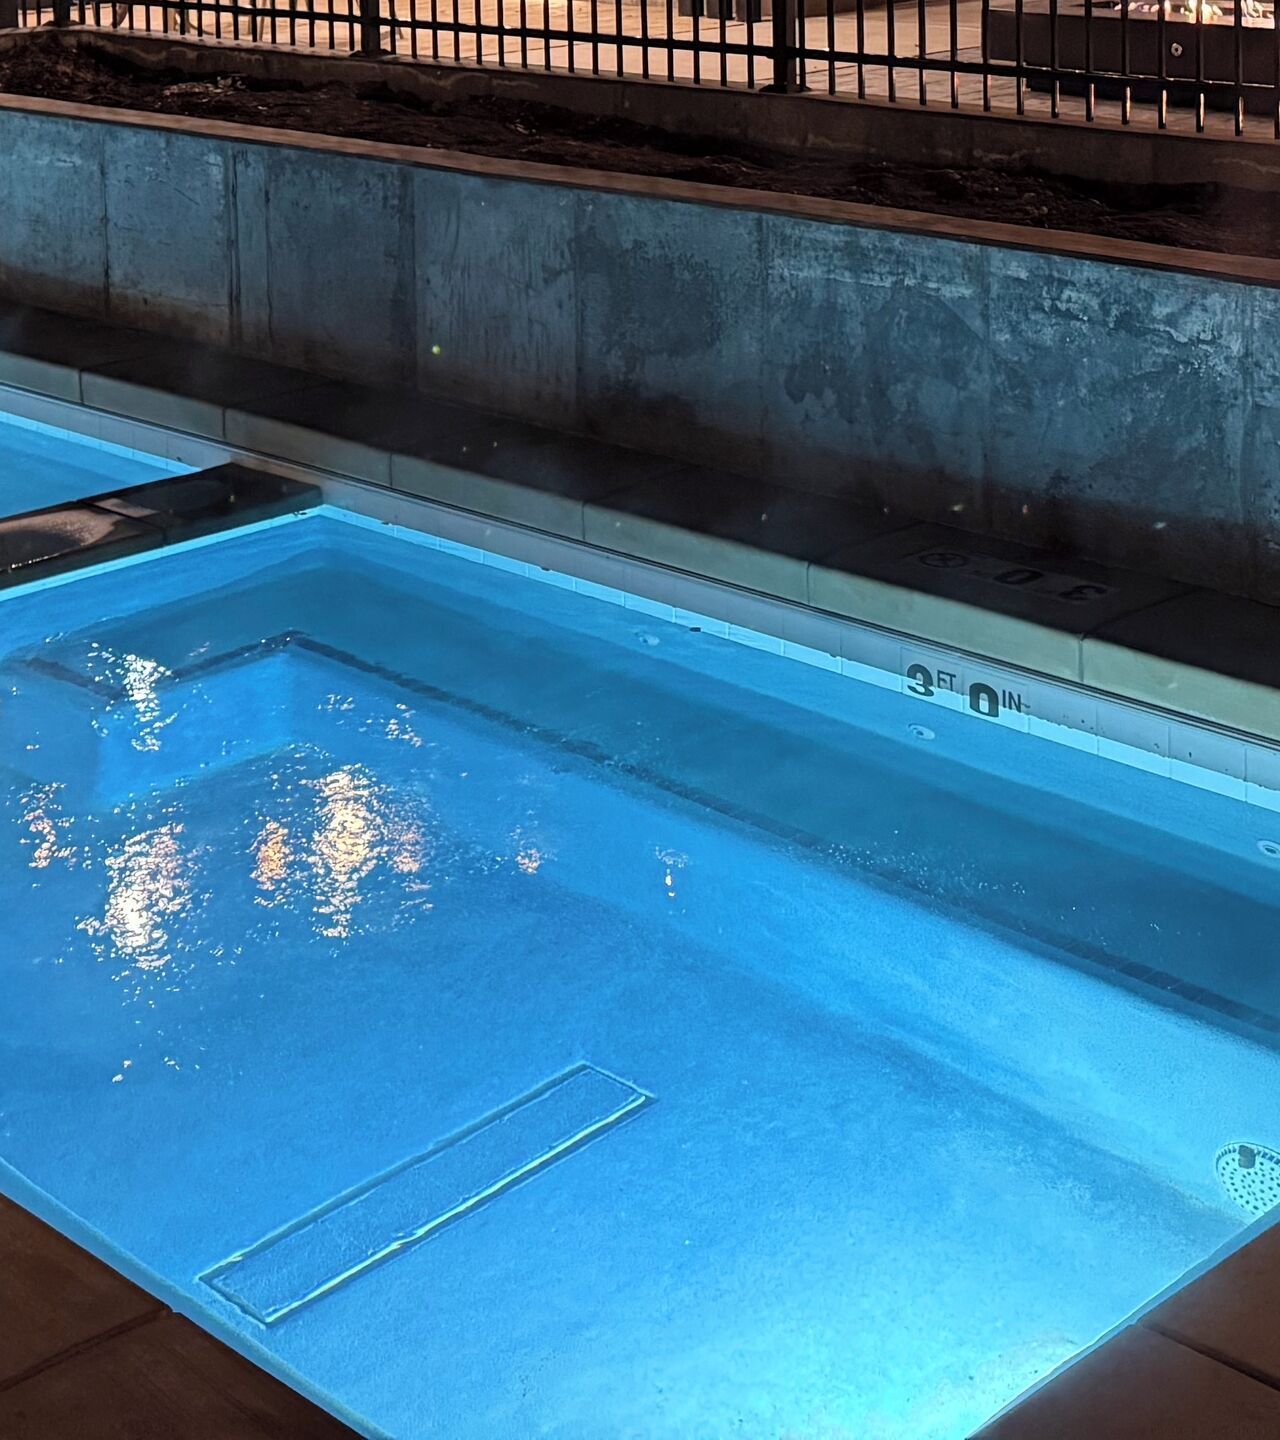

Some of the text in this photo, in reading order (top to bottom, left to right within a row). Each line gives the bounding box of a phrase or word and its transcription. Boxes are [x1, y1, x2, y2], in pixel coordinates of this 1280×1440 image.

[907, 663, 1022, 717] 3 FT 0 IN
